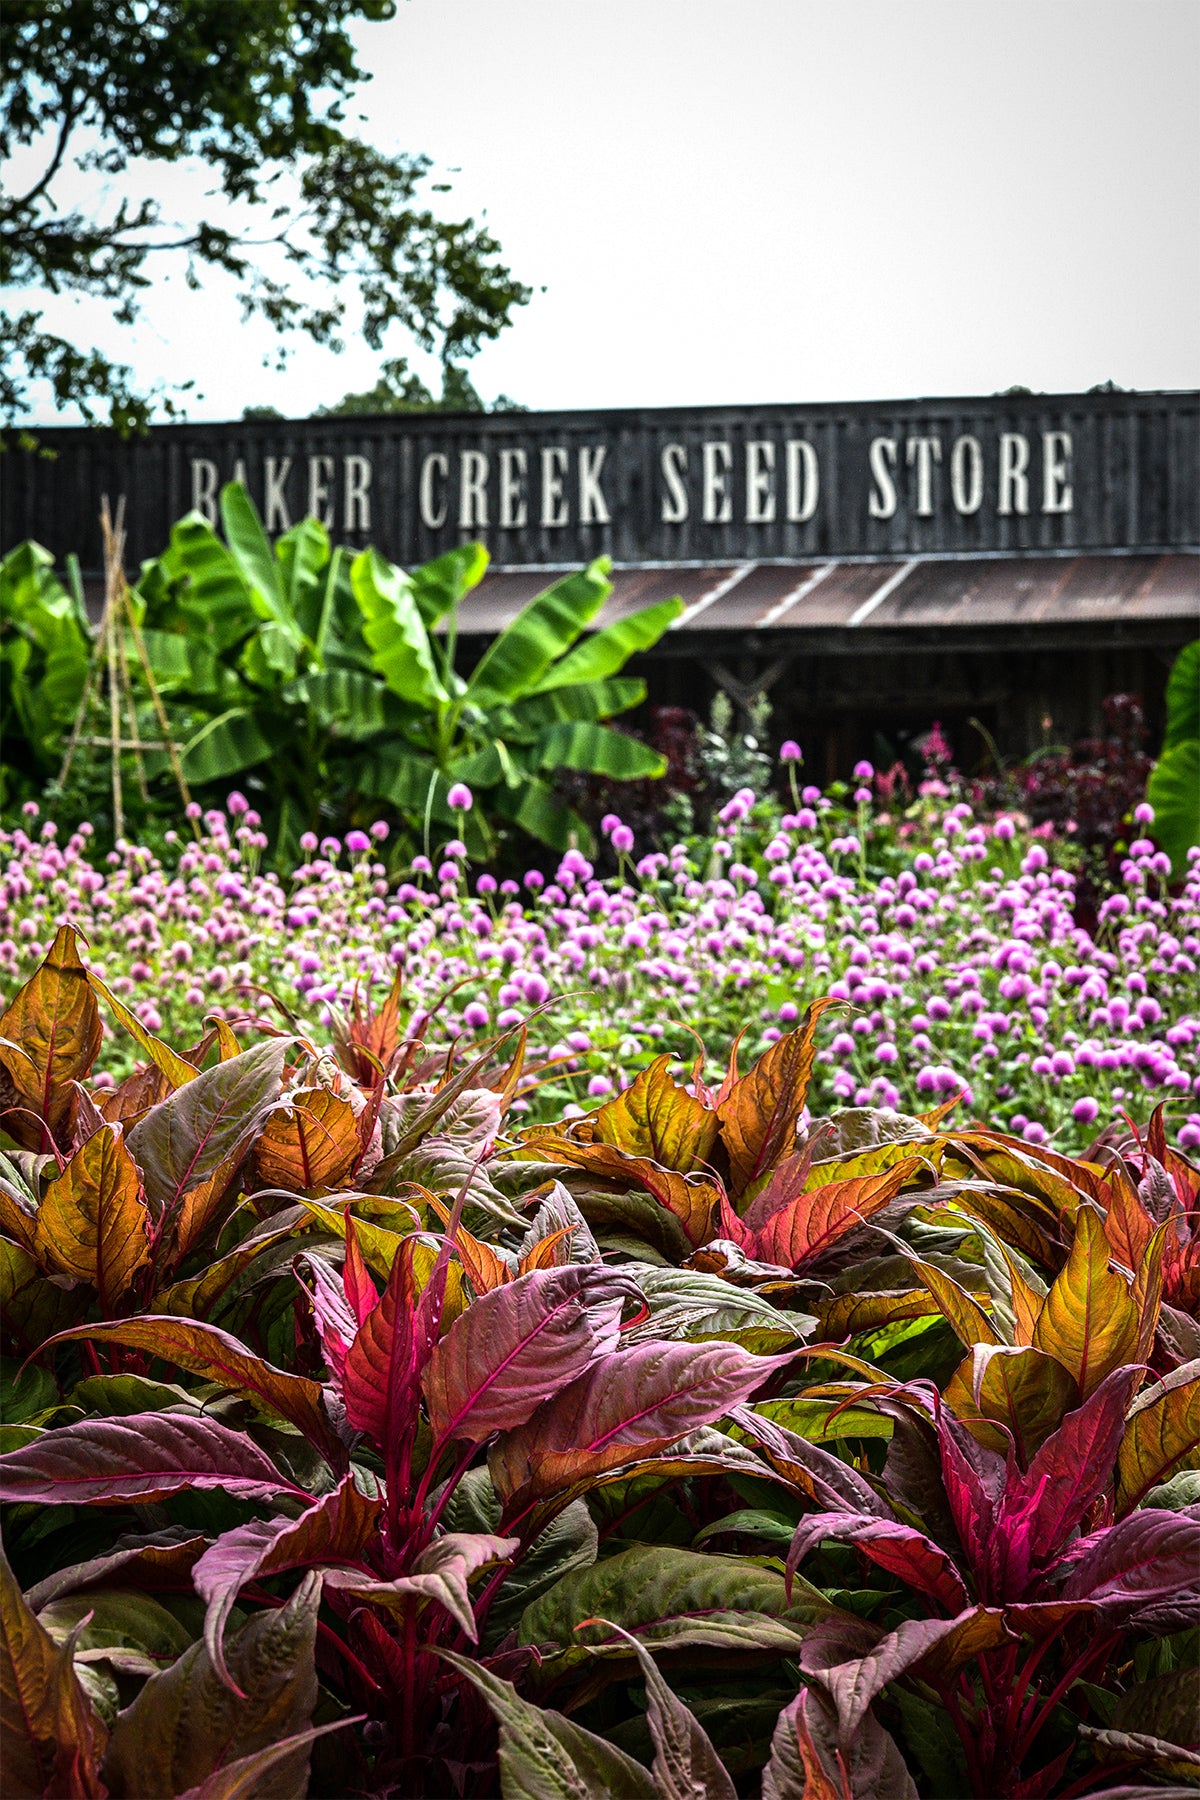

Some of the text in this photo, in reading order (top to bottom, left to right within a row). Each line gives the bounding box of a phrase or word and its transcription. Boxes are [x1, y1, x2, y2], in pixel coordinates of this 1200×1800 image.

[191, 431, 1073, 532] BKER CREEK SEED STORE
